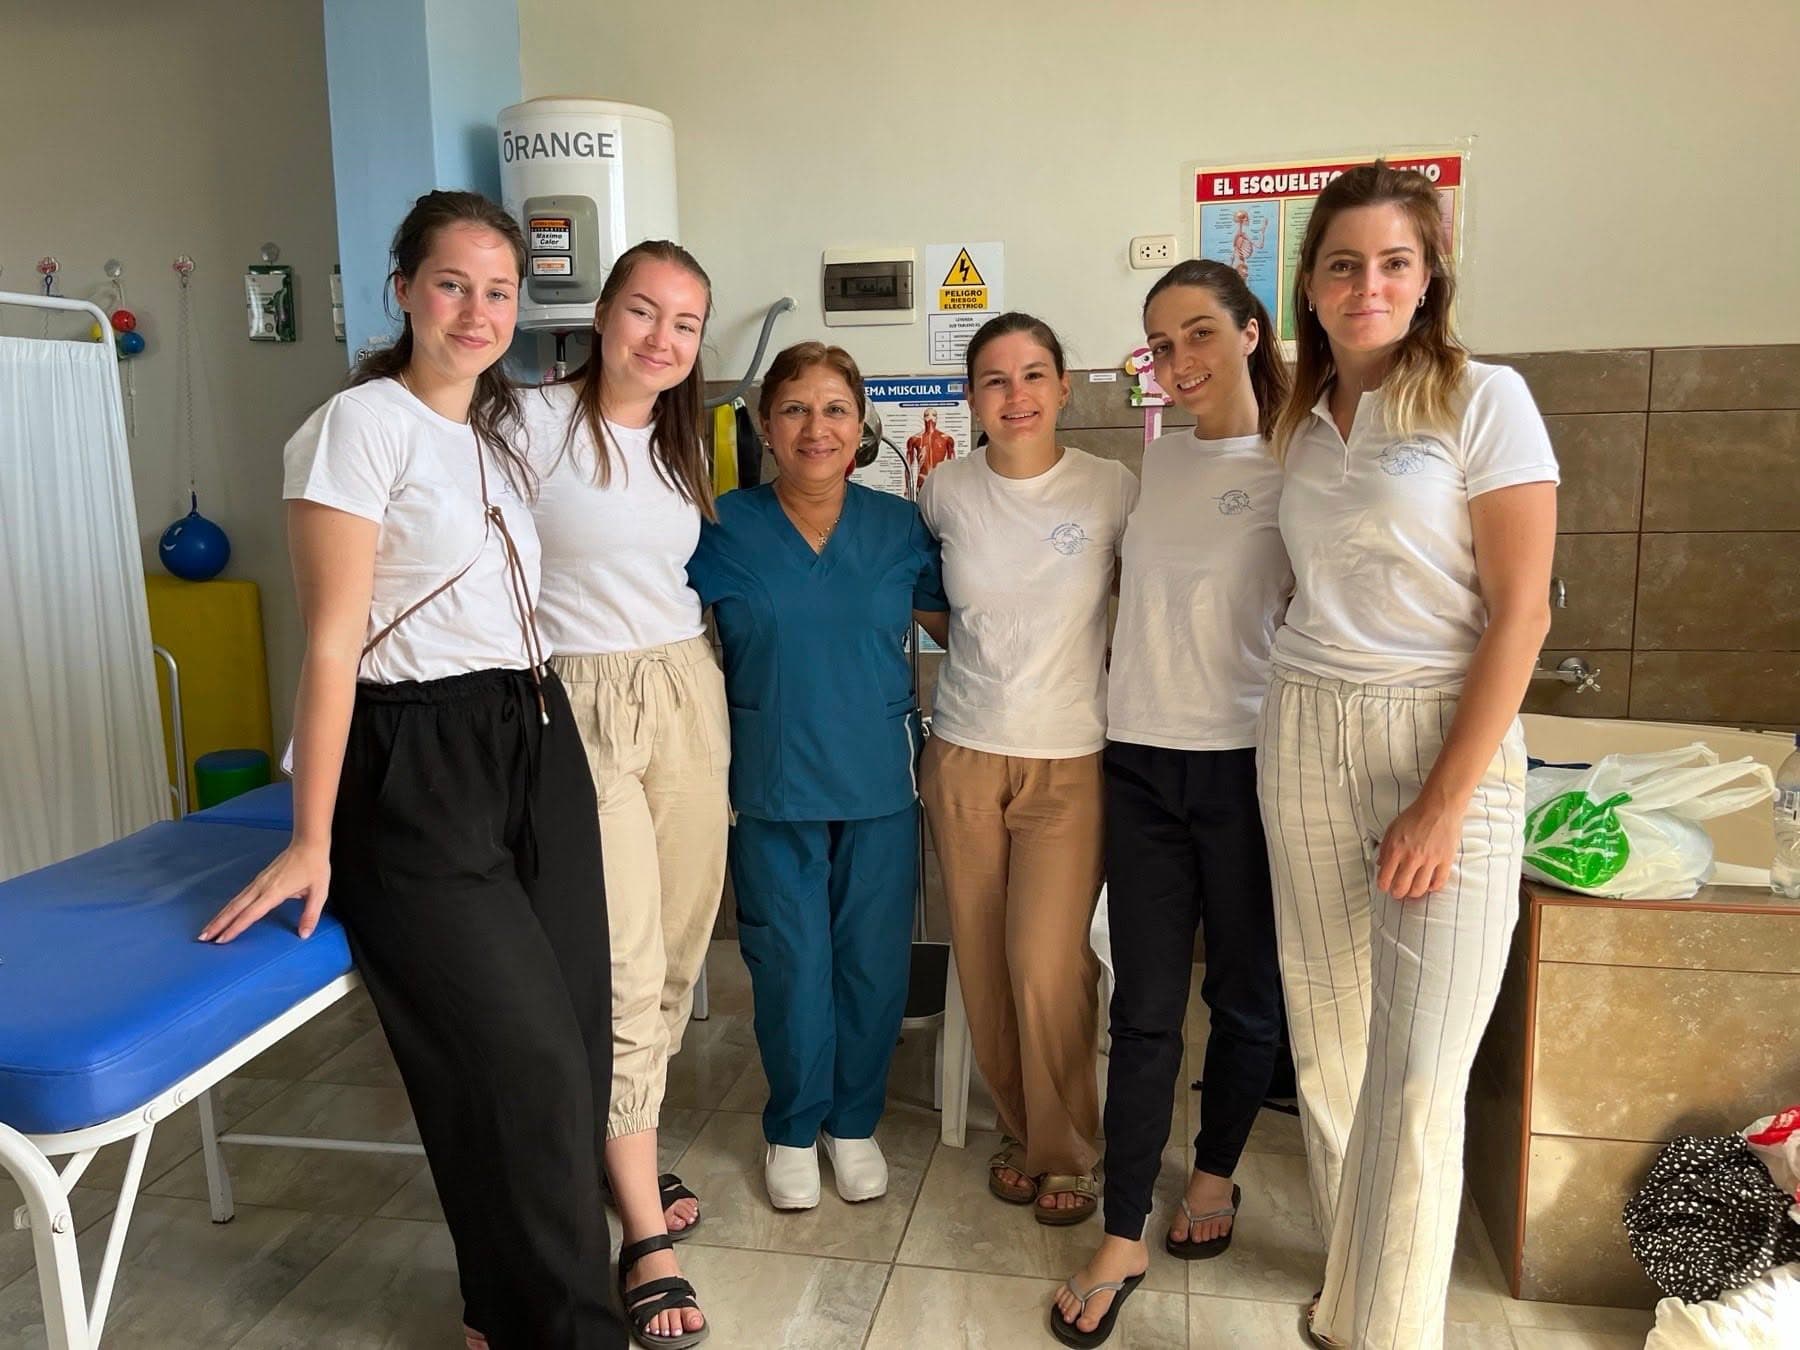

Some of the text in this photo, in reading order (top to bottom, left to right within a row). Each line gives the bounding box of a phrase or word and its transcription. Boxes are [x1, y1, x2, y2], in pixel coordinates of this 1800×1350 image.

[1213, 178, 1234, 196] EL
[864, 384, 942, 396] EMA MUSCULAR
